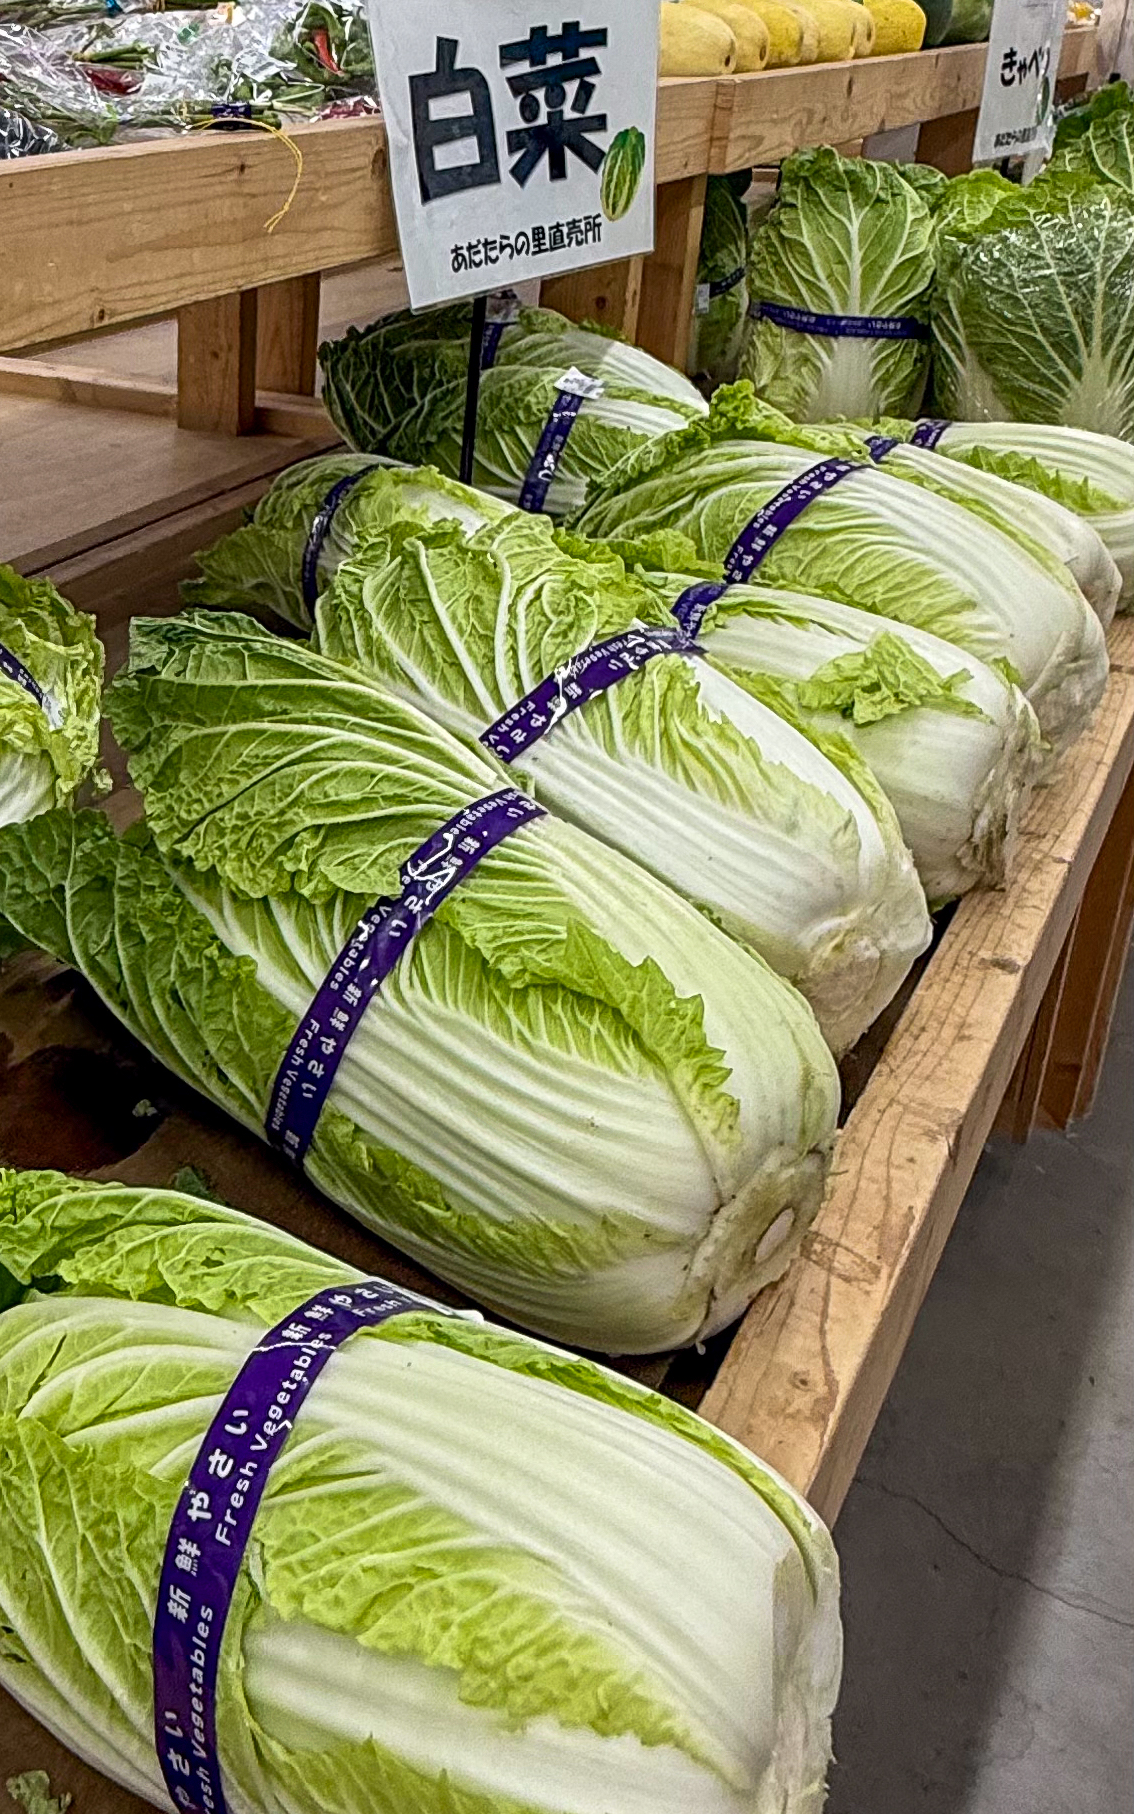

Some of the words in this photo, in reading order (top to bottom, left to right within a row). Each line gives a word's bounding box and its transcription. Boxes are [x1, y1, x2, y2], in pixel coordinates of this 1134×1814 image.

[409, 20, 609, 207] 白菜
[450, 213, 603, 273] あだたらの里直売所
[449, 797, 509, 836] Vegetable
[290, 1017, 321, 1067] Fresh
[301, 980, 363, 1099] 新鮮やさい
[215, 1461, 259, 1547] Fresh
[249, 1331, 334, 1452] Vegetables
[166, 1409, 250, 1625] 新鮮やさい
[190, 1604, 214, 1760] Vegetables
